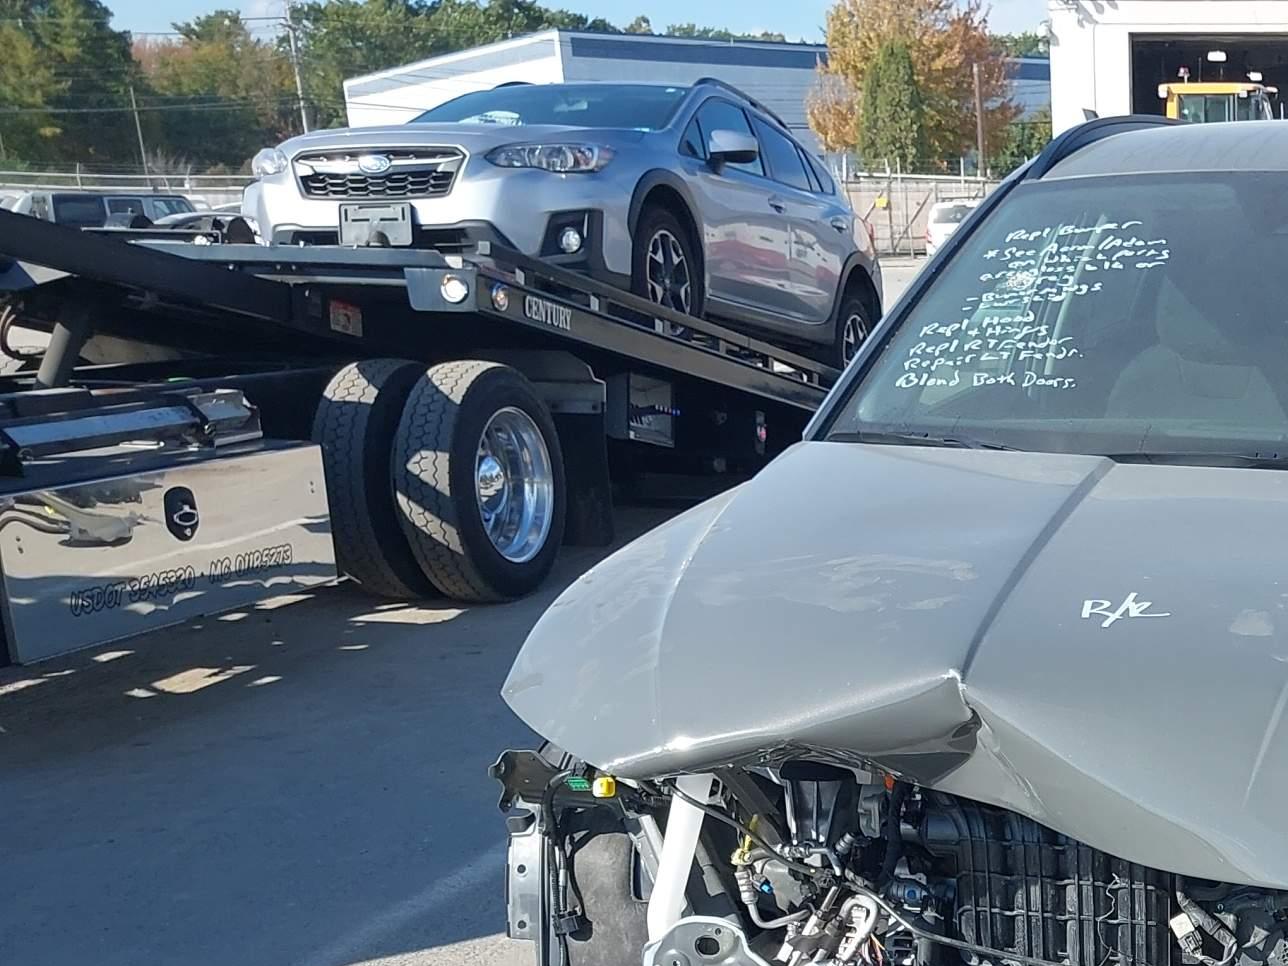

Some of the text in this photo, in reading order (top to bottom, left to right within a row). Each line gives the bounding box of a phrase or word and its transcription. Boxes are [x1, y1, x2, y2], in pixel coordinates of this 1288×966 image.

[525, 295, 572, 331] CENTURY
[983, 310, 1035, 327] Hood
[973, 372, 1016, 387] Both
[70, 581, 126, 617] USDOT
[208, 556, 232, 585] MC
